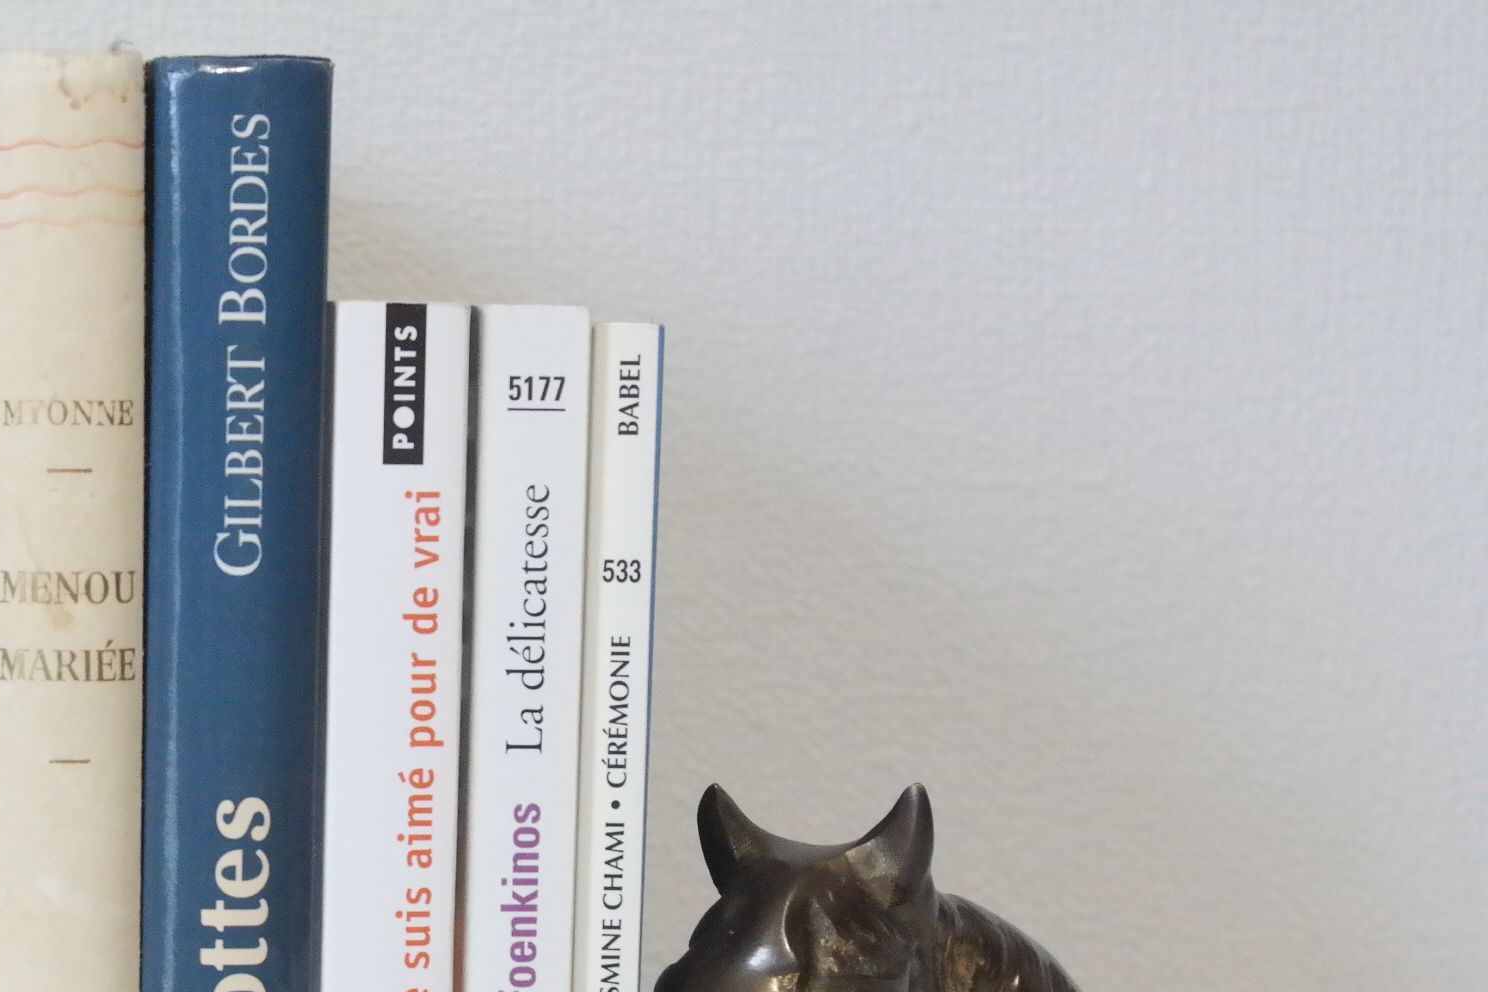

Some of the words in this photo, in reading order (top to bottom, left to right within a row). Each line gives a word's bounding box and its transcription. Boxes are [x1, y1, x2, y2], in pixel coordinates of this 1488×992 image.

[218, 113, 272, 326] BORDES
[392, 324, 418, 450] POINTS
[508, 375, 566, 402] 5177
[617, 353, 641, 437] BABEL
[213, 344, 266, 577] GILBERT
[404, 490, 441, 569] vrai
[602, 559, 642, 583] 533
[0, 569, 136, 605] MENOU
[402, 586, 439, 636] de
[505, 482, 550, 691] délicatesse
[409, 652, 444, 748] pour
[505, 704, 544, 755] La
[601, 635, 631, 788] CÉRÉMONIE
[396, 767, 435, 869] aimé
[602, 821, 626, 911] CHAMI
[395, 887, 433, 970] suis
